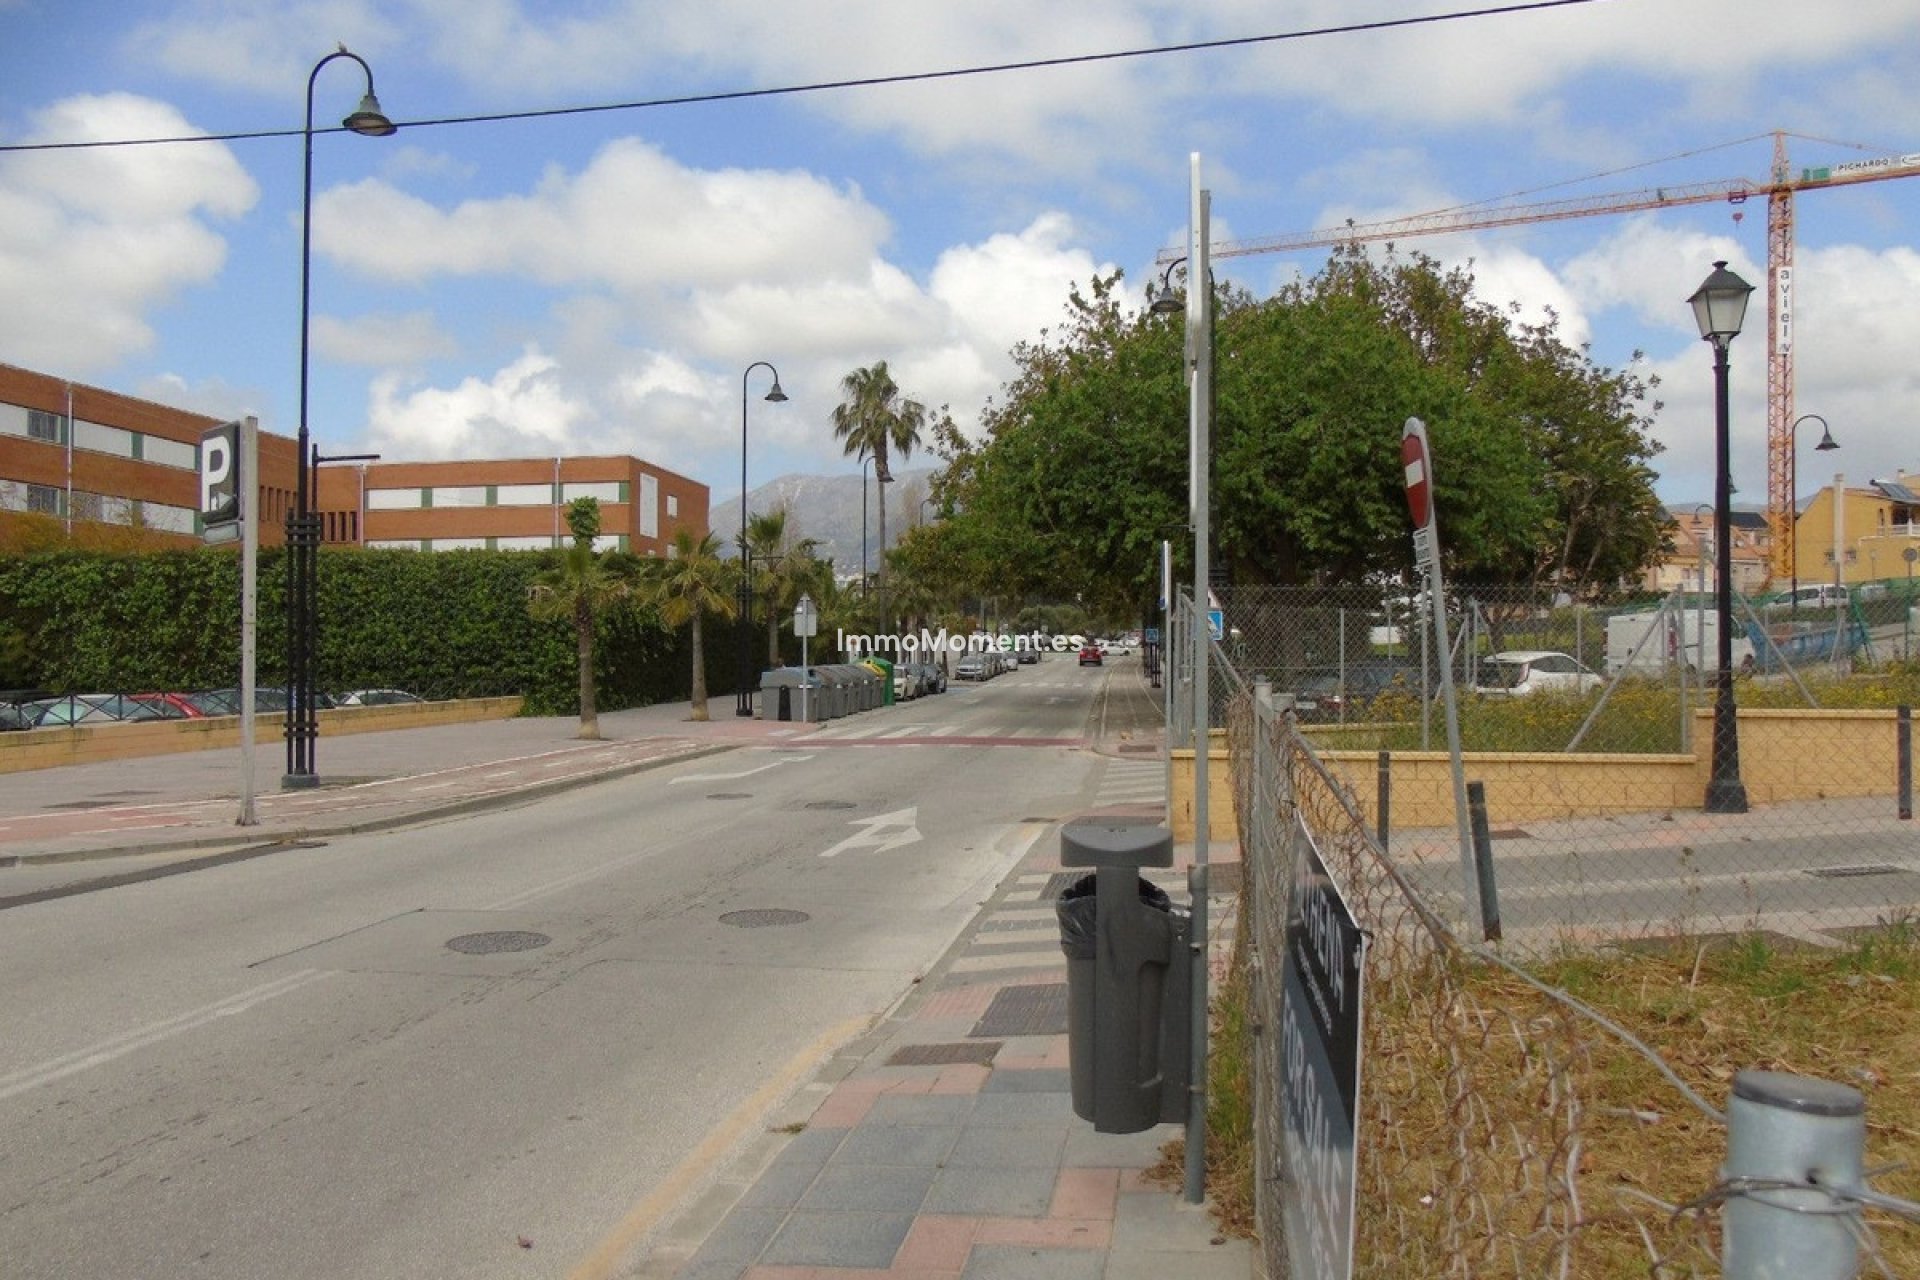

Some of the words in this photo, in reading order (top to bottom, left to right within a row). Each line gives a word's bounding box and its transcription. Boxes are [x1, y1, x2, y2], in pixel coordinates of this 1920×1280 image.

[1838, 158, 1889, 171] PICHARDO
[202, 436, 231, 513] P
[1281, 989, 1305, 1114] FOR
[1304, 1063, 1342, 1253] SALE
